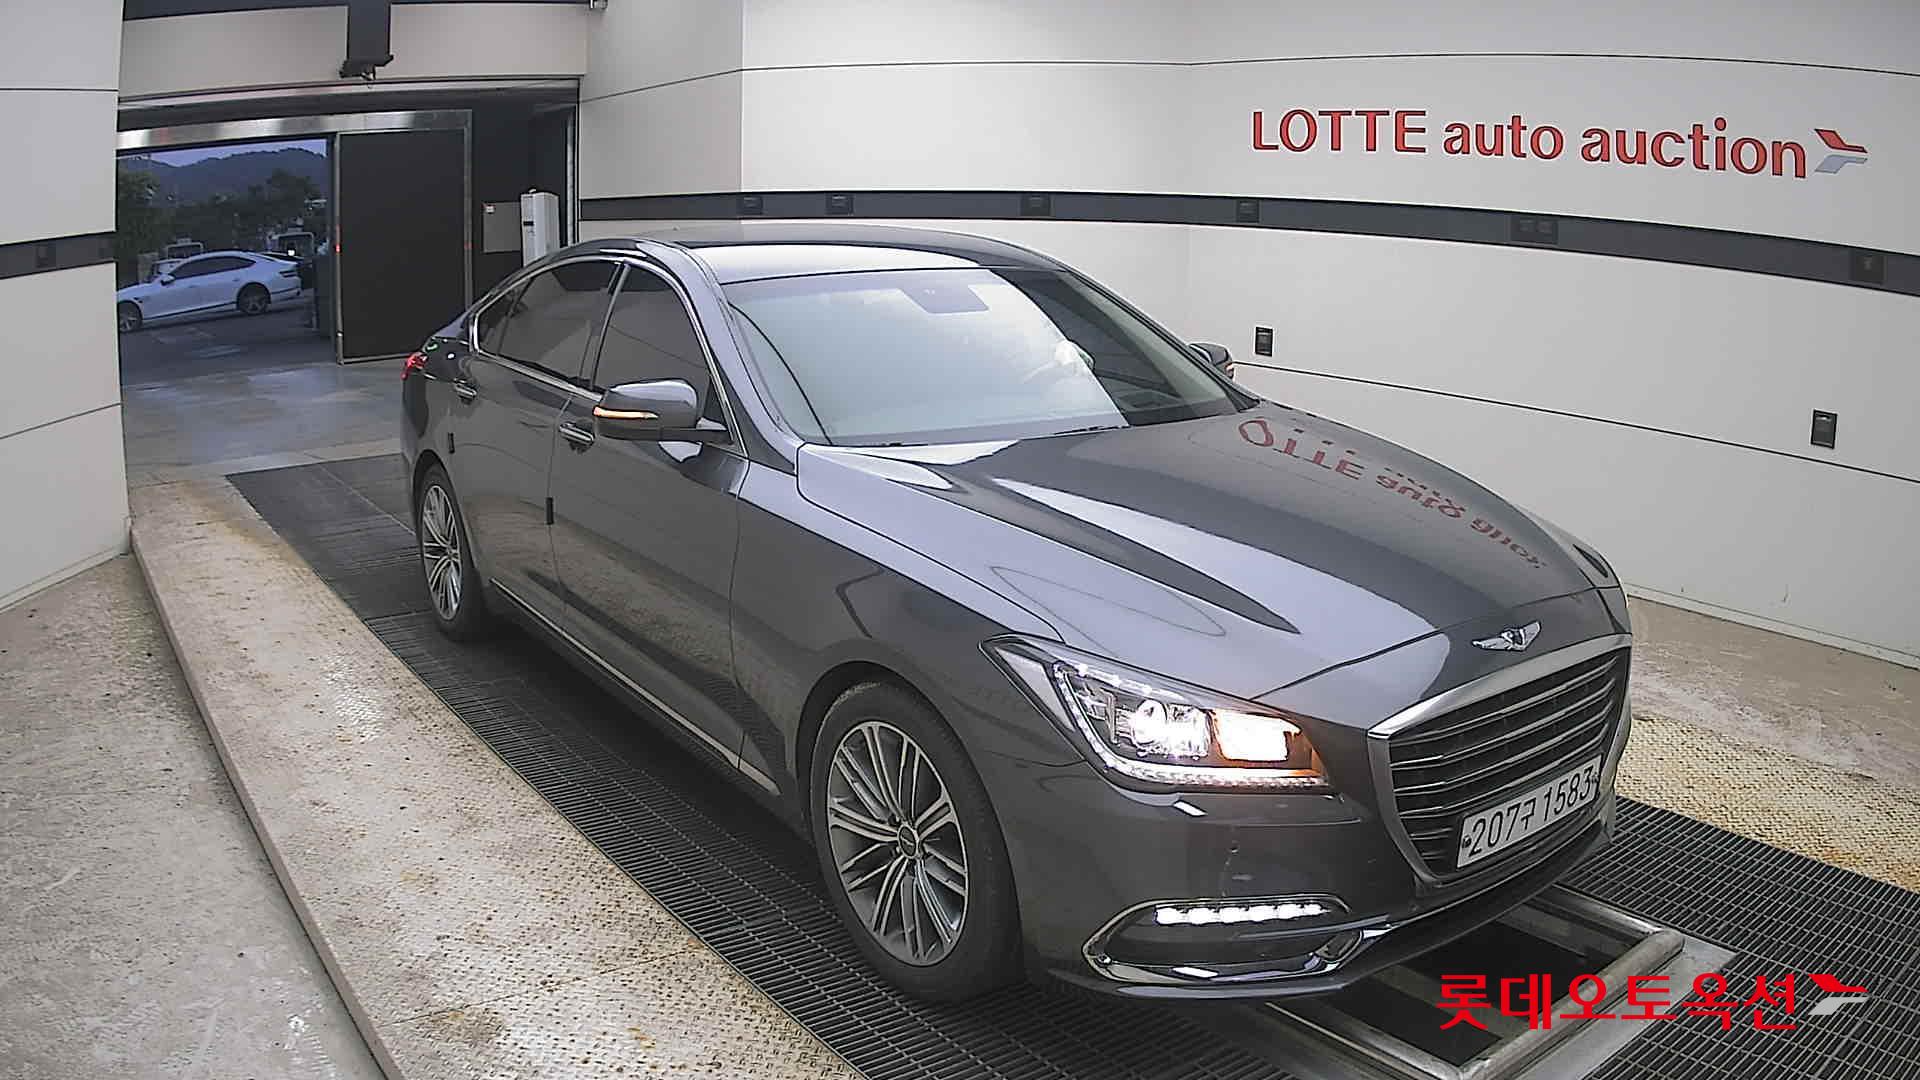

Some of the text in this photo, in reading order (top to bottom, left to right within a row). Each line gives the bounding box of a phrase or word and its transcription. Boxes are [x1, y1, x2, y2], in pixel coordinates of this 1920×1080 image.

[1253, 110, 1807, 179] LOTTE auto auction
[1469, 766, 1593, 857] 207구 1583
